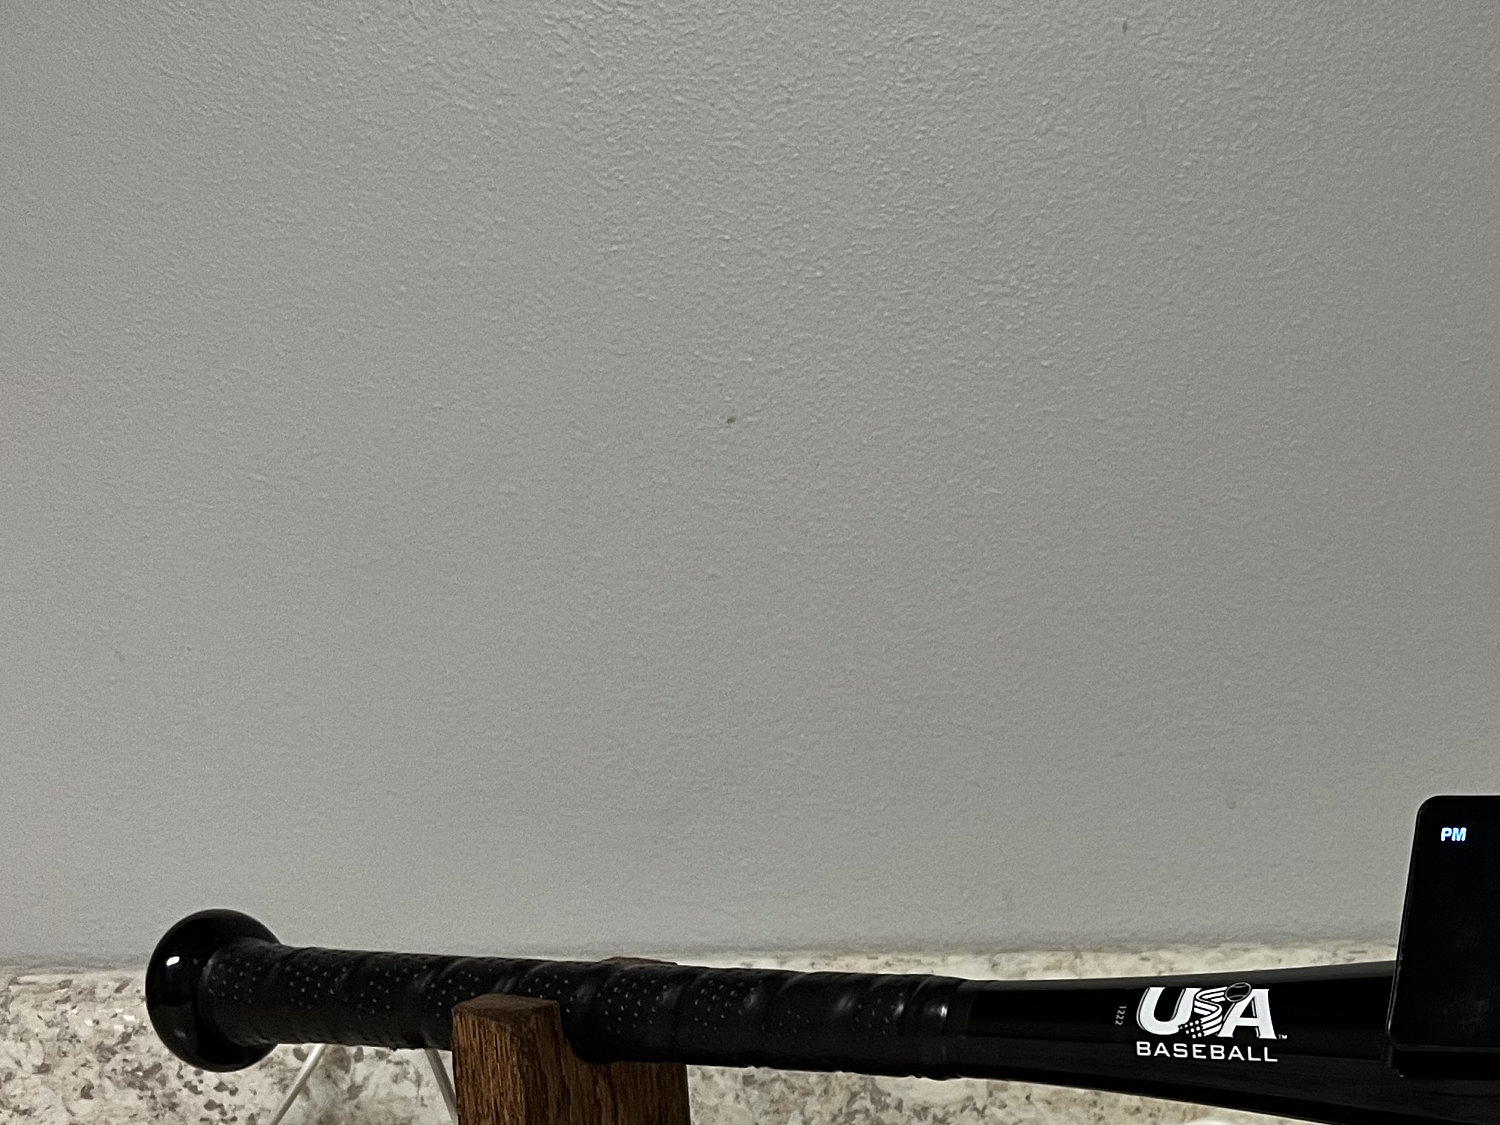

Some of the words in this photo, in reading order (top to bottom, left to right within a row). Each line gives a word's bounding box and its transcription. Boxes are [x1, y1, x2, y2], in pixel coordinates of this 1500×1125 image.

[1440, 827, 1467, 841] PM
[1136, 981, 1277, 1040] USA
[1136, 1041, 1278, 1063] BASEBALL
